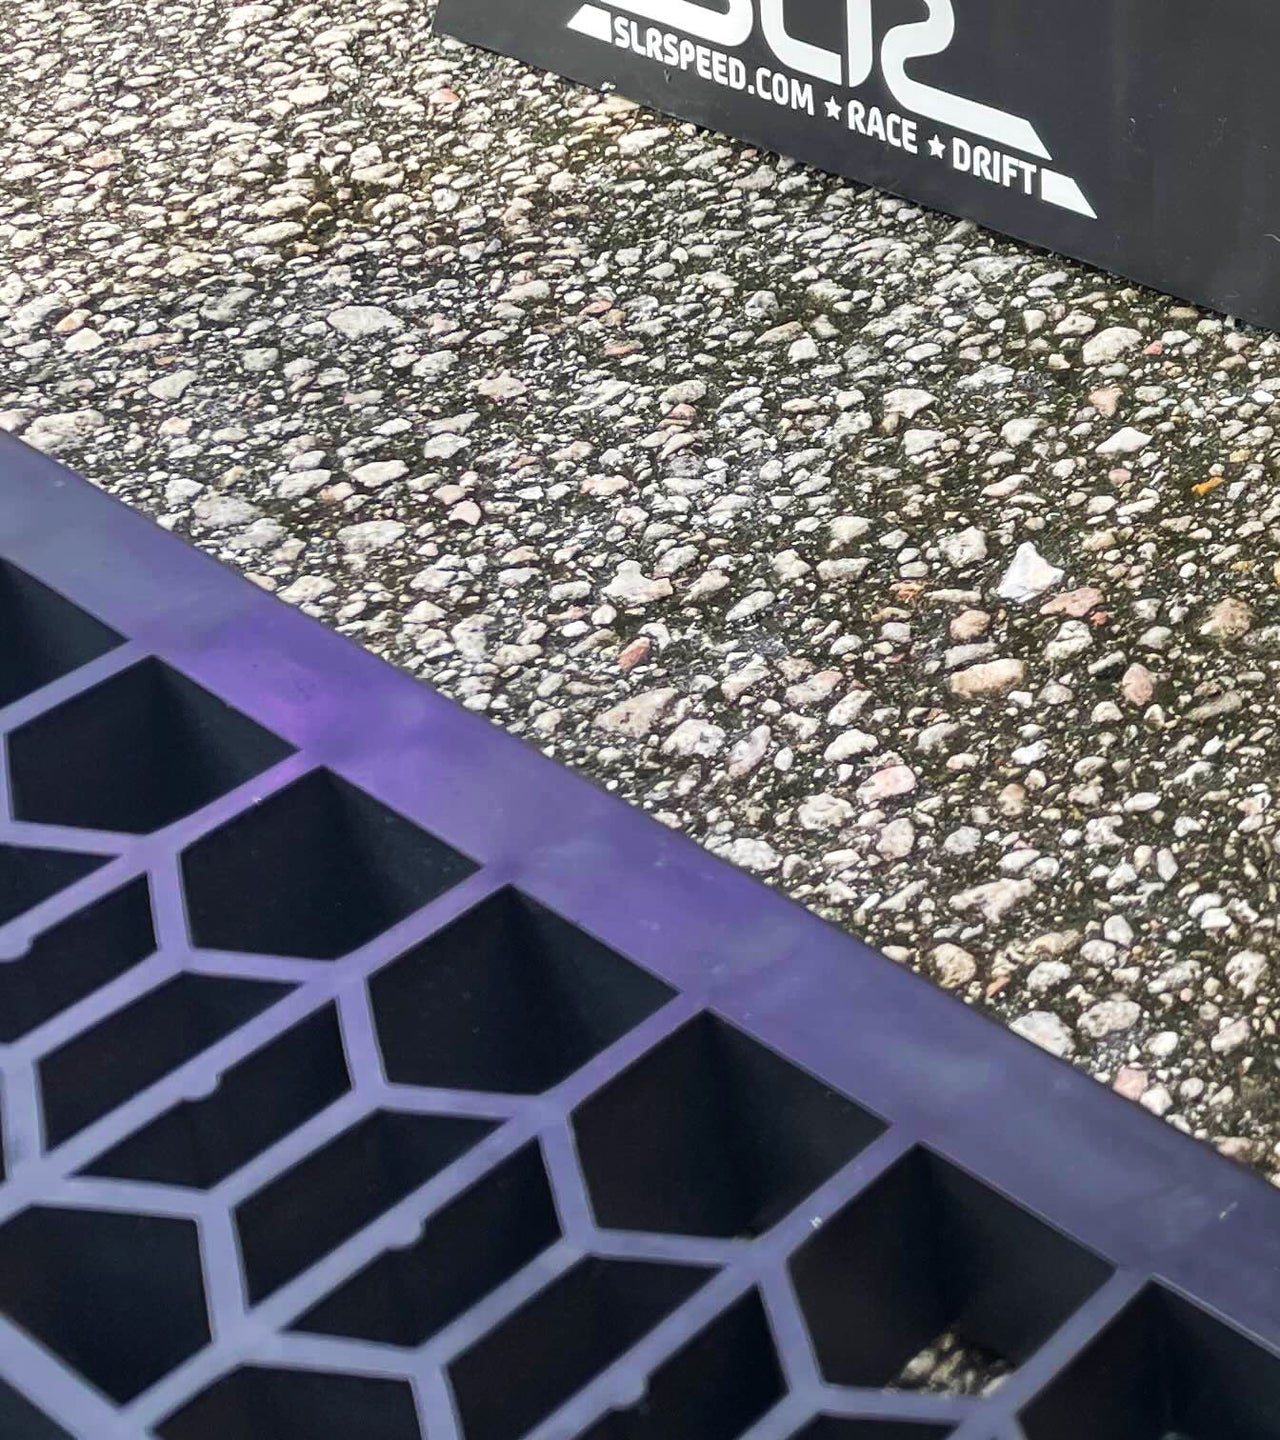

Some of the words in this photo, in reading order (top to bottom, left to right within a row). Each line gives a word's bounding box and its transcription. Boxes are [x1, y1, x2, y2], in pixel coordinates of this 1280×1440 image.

[613, 15, 815, 116] SLRSPEED.COM
[847, 100, 918, 155] RACE
[952, 139, 1038, 196] DRIFT
